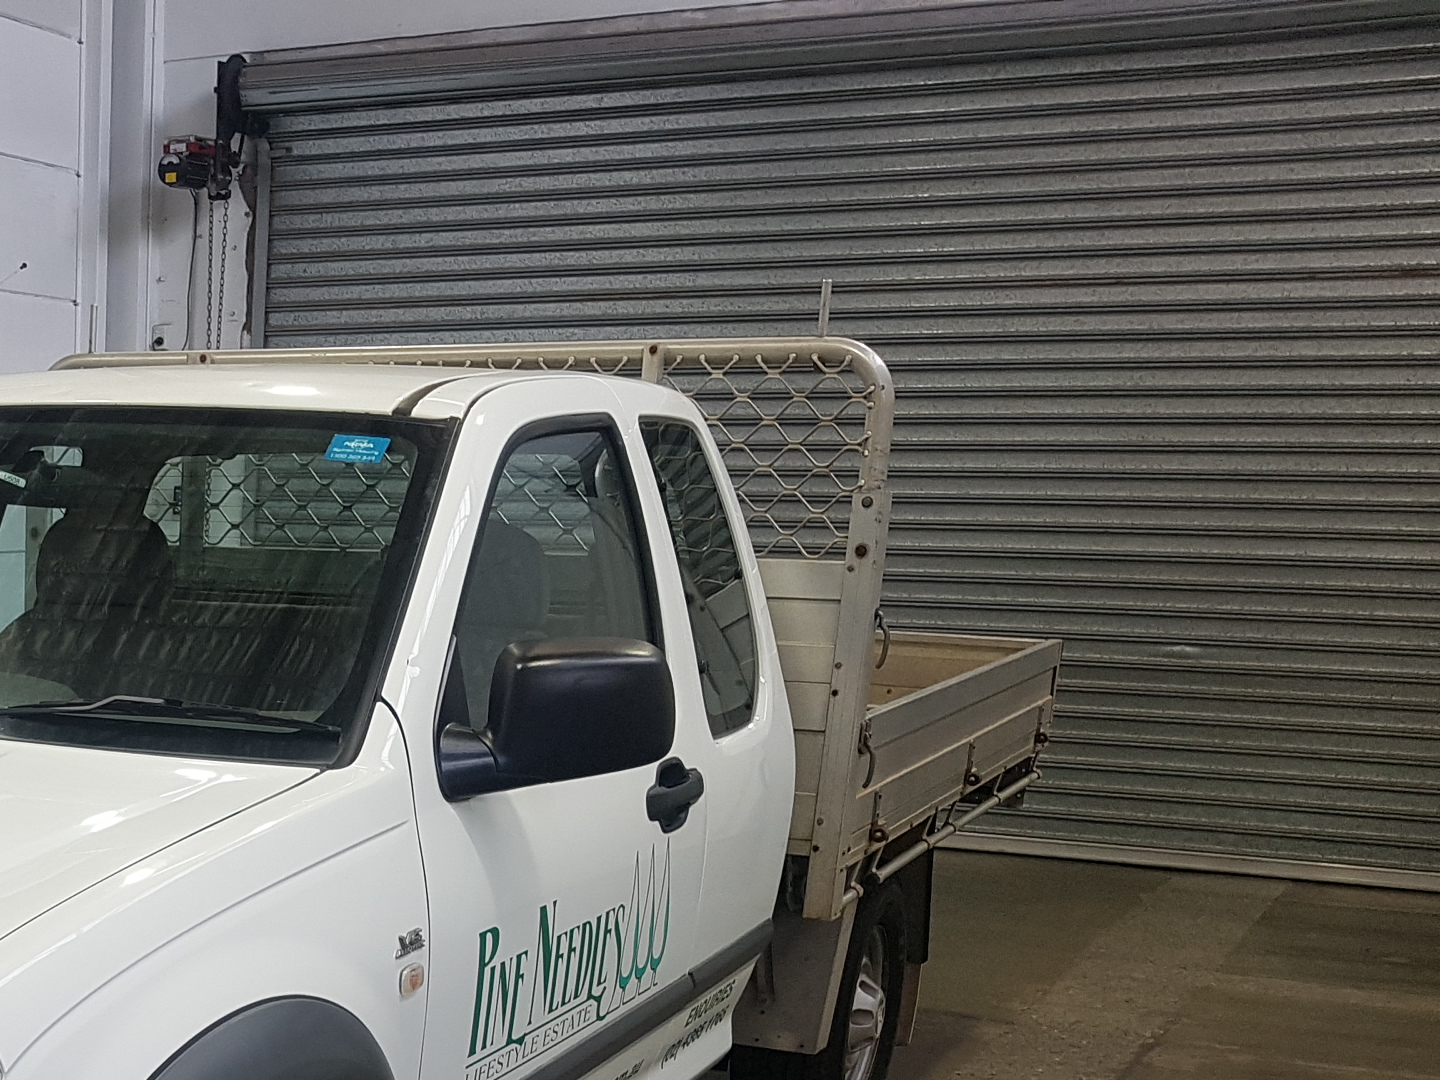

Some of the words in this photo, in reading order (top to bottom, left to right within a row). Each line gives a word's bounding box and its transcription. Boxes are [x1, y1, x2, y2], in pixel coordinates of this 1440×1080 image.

[467, 926, 529, 1058] PINE
[527, 899, 626, 1022] NEEDLES
[542, 1003, 593, 1048] ESTATE
